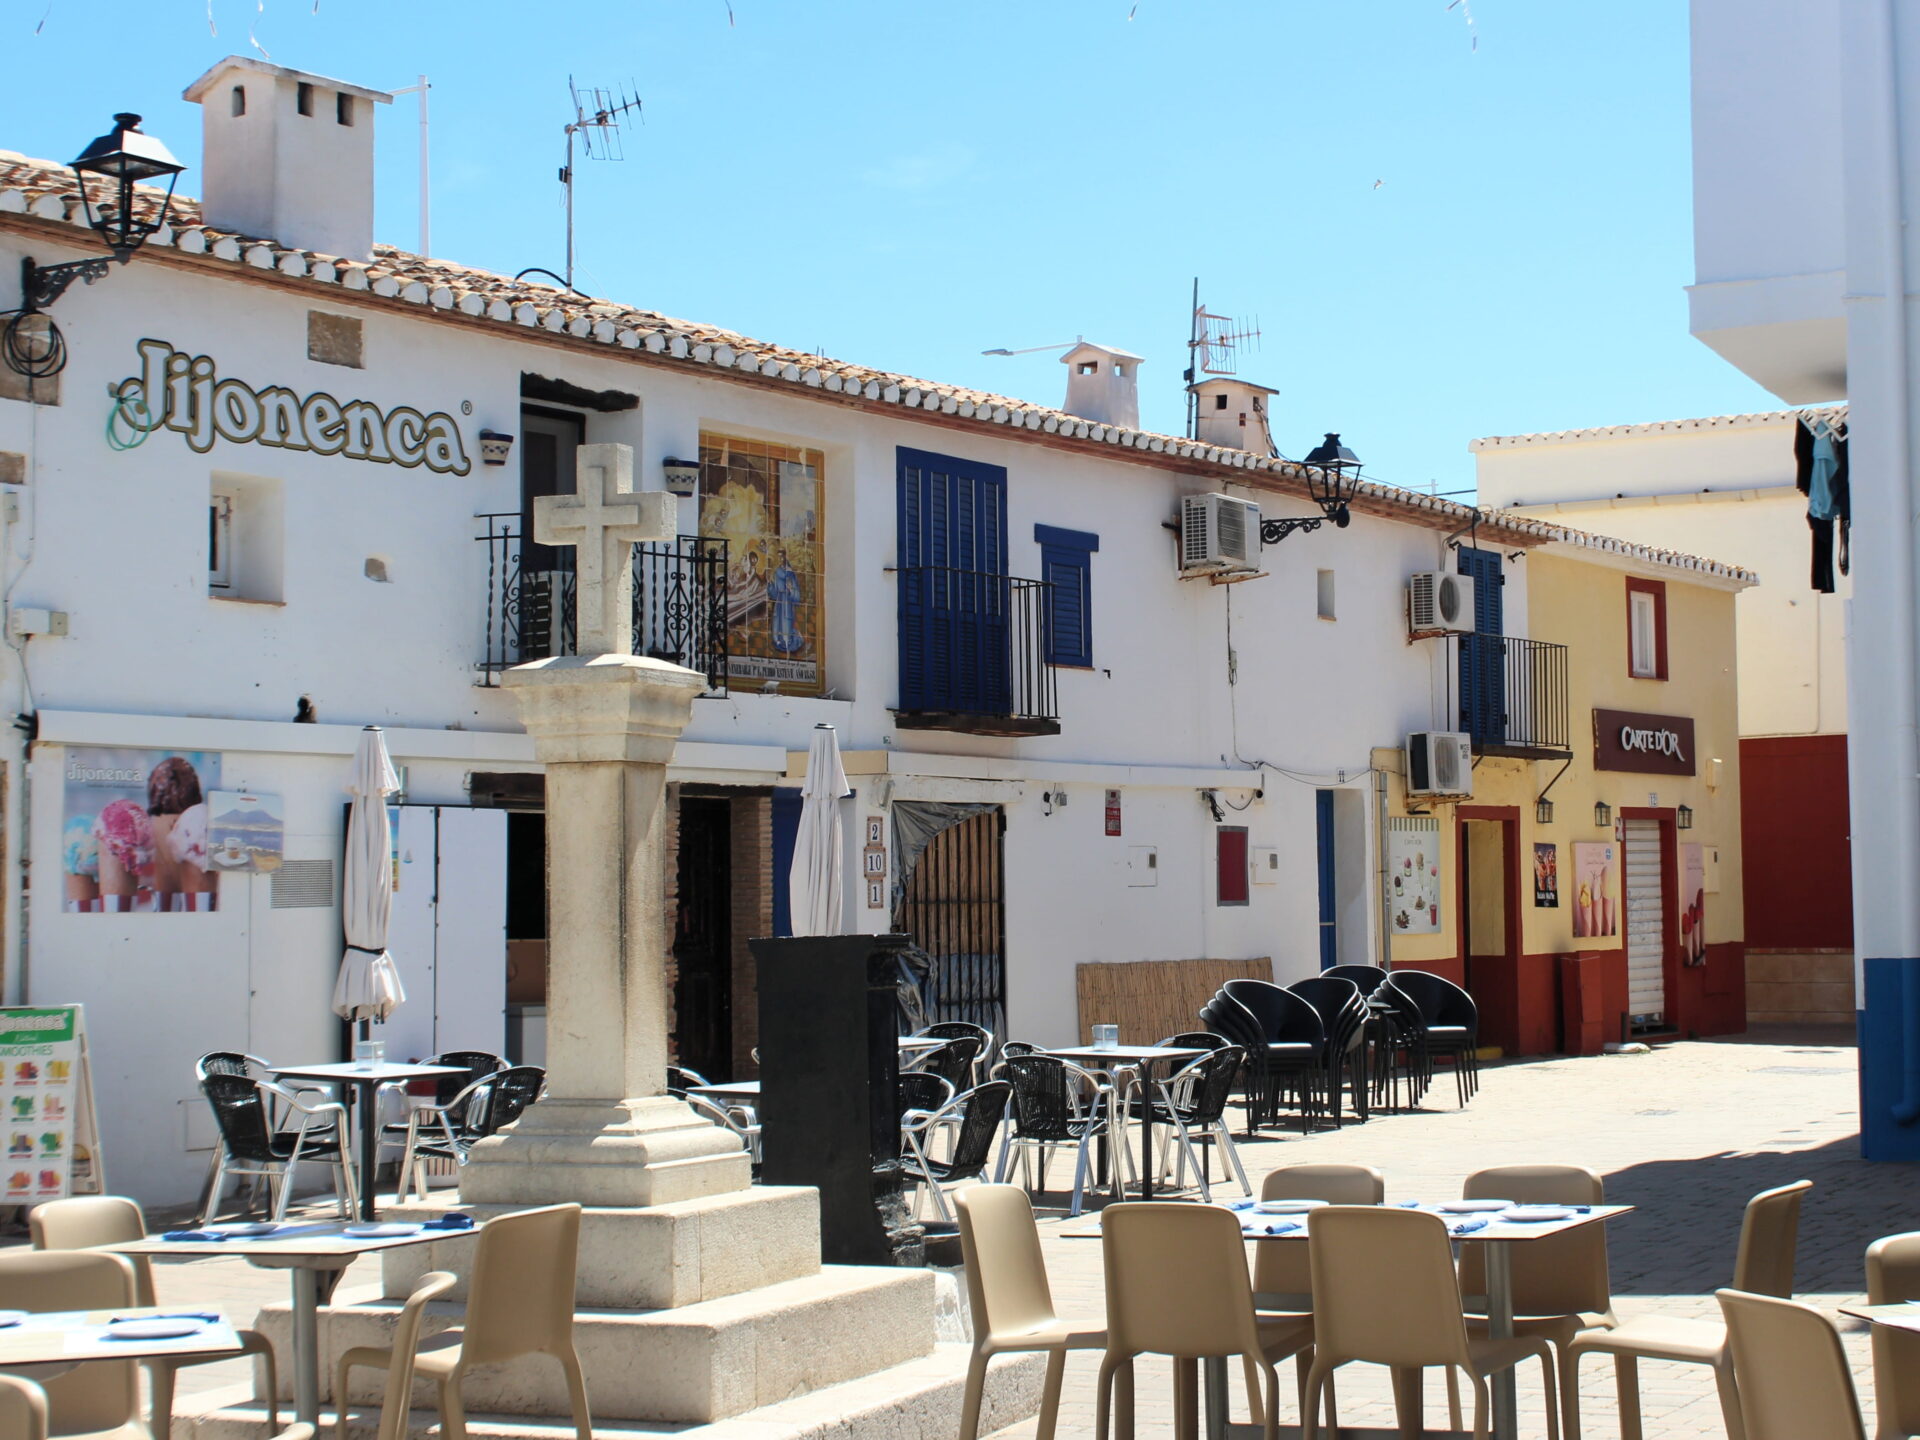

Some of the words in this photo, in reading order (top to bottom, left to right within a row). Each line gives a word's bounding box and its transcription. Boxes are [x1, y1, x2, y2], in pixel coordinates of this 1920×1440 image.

[117, 338, 471, 478] Jijonenca
[1621, 726, 1654, 753] CARTE
[1655, 728, 1685, 762] D'OR
[67, 760, 144, 783] Jijonenca
[872, 824, 878, 840] 2
[868, 854, 882, 871] 10
[872, 886, 878, 902] 1
